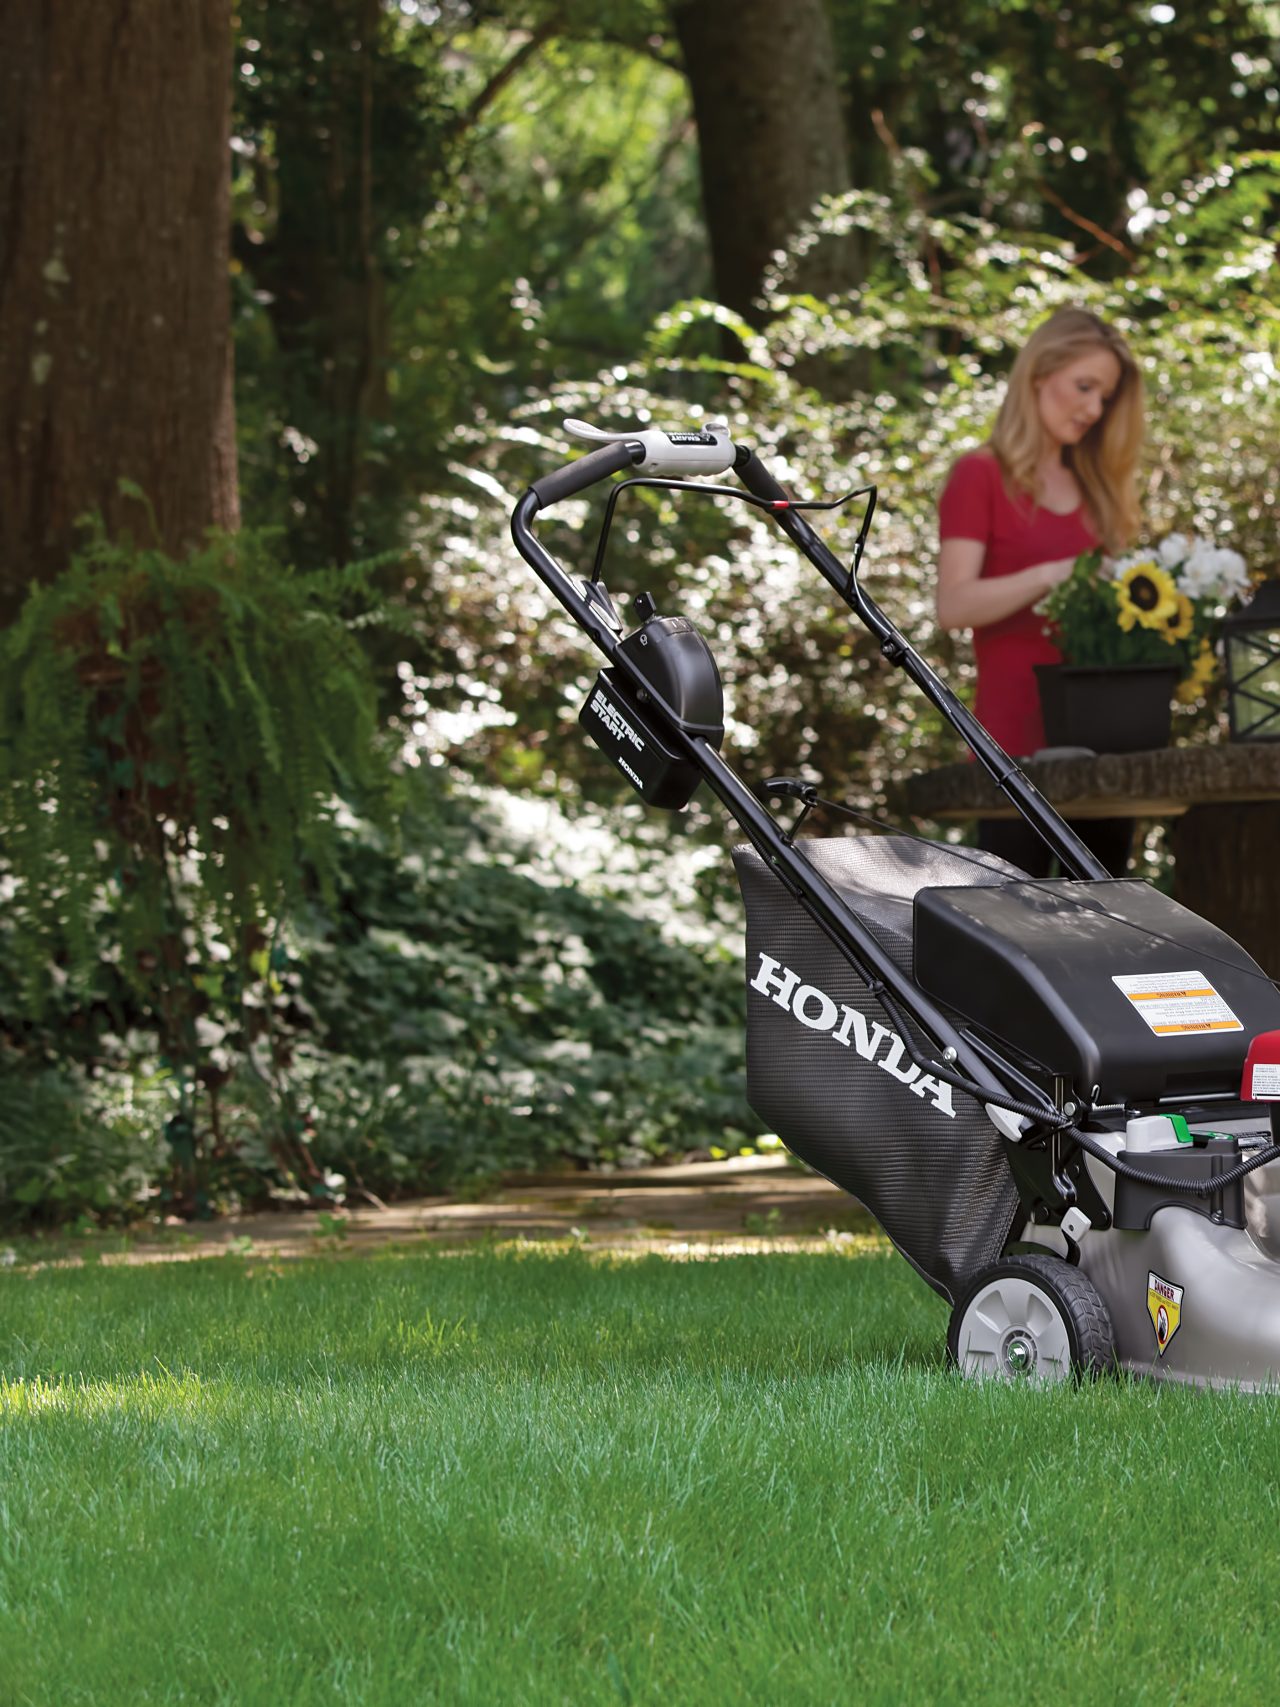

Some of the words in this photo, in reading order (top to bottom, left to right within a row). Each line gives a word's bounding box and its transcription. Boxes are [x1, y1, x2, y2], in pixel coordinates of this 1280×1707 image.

[590, 699, 625, 741] START
[595, 690, 645, 752] ELECTRIC
[618, 756, 644, 790] HONDA
[750, 952, 956, 1119] HONDA
[1154, 1280, 1175, 1301] DANGER
